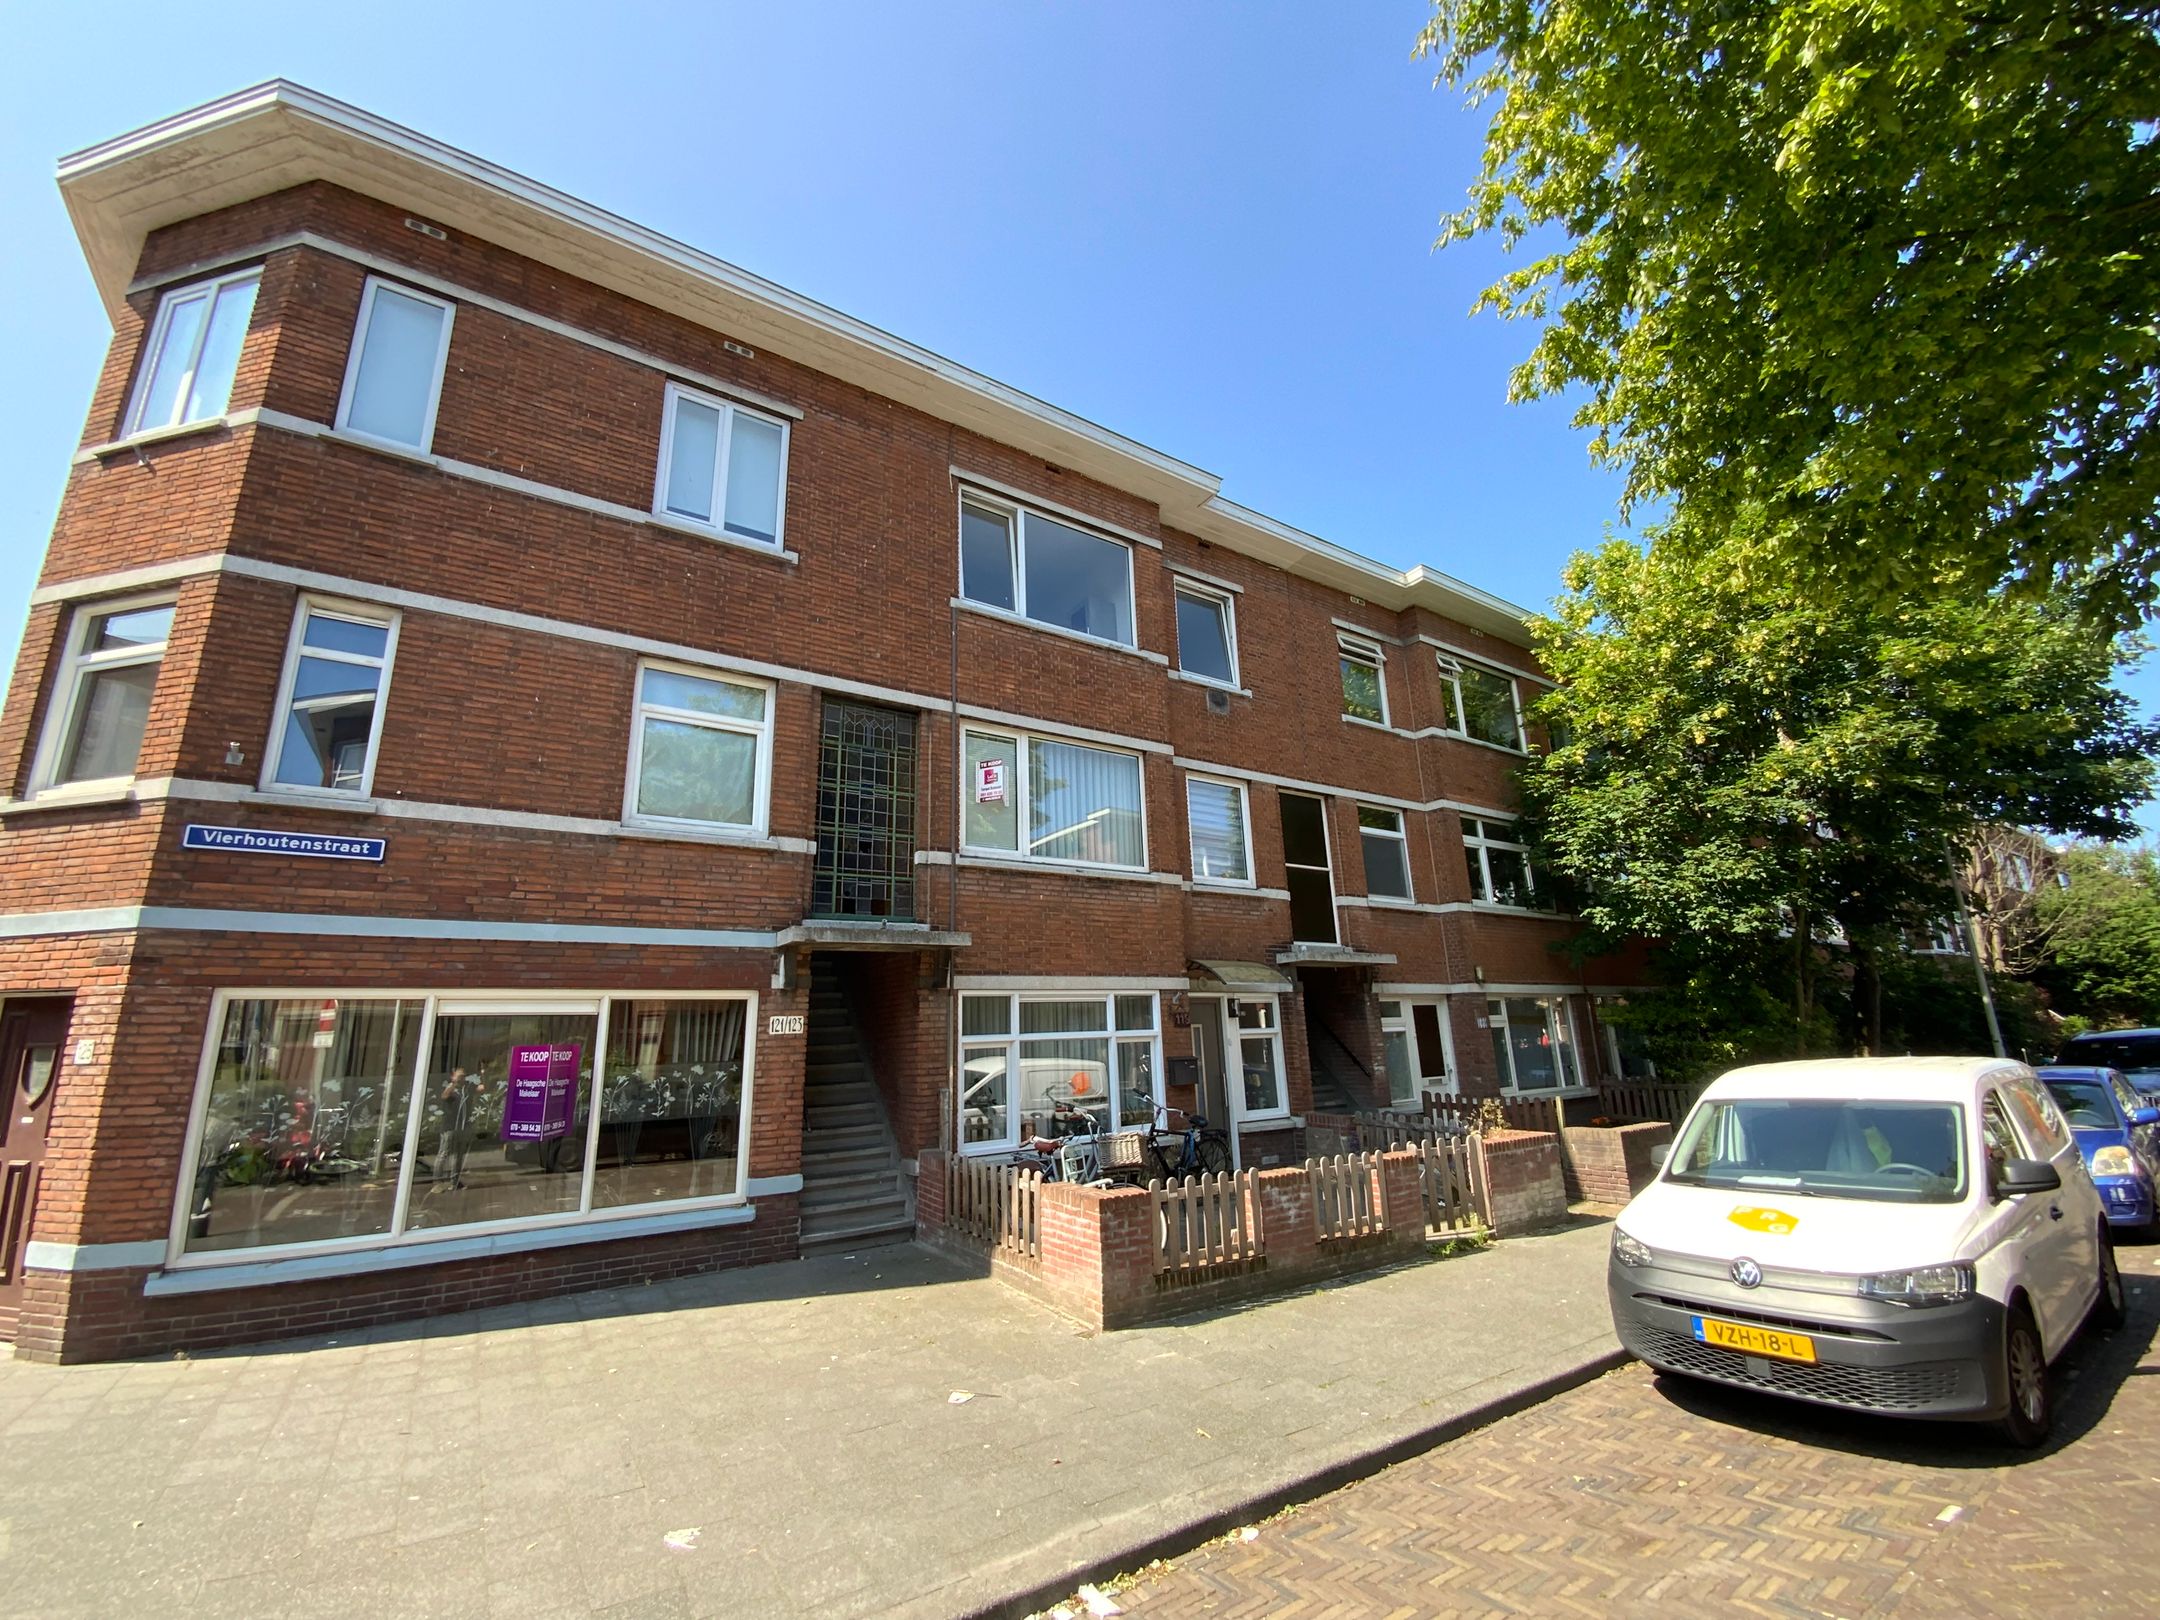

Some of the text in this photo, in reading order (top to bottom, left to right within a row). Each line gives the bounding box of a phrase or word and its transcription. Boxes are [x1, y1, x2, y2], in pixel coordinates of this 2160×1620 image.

[203, 829, 370, 854] Vierhoutenstraat
[771, 1016, 803, 1034] 121/123
[520, 1051, 549, 1062] TE KOOP
[1712, 1323, 1803, 1356] VZH-18-L
